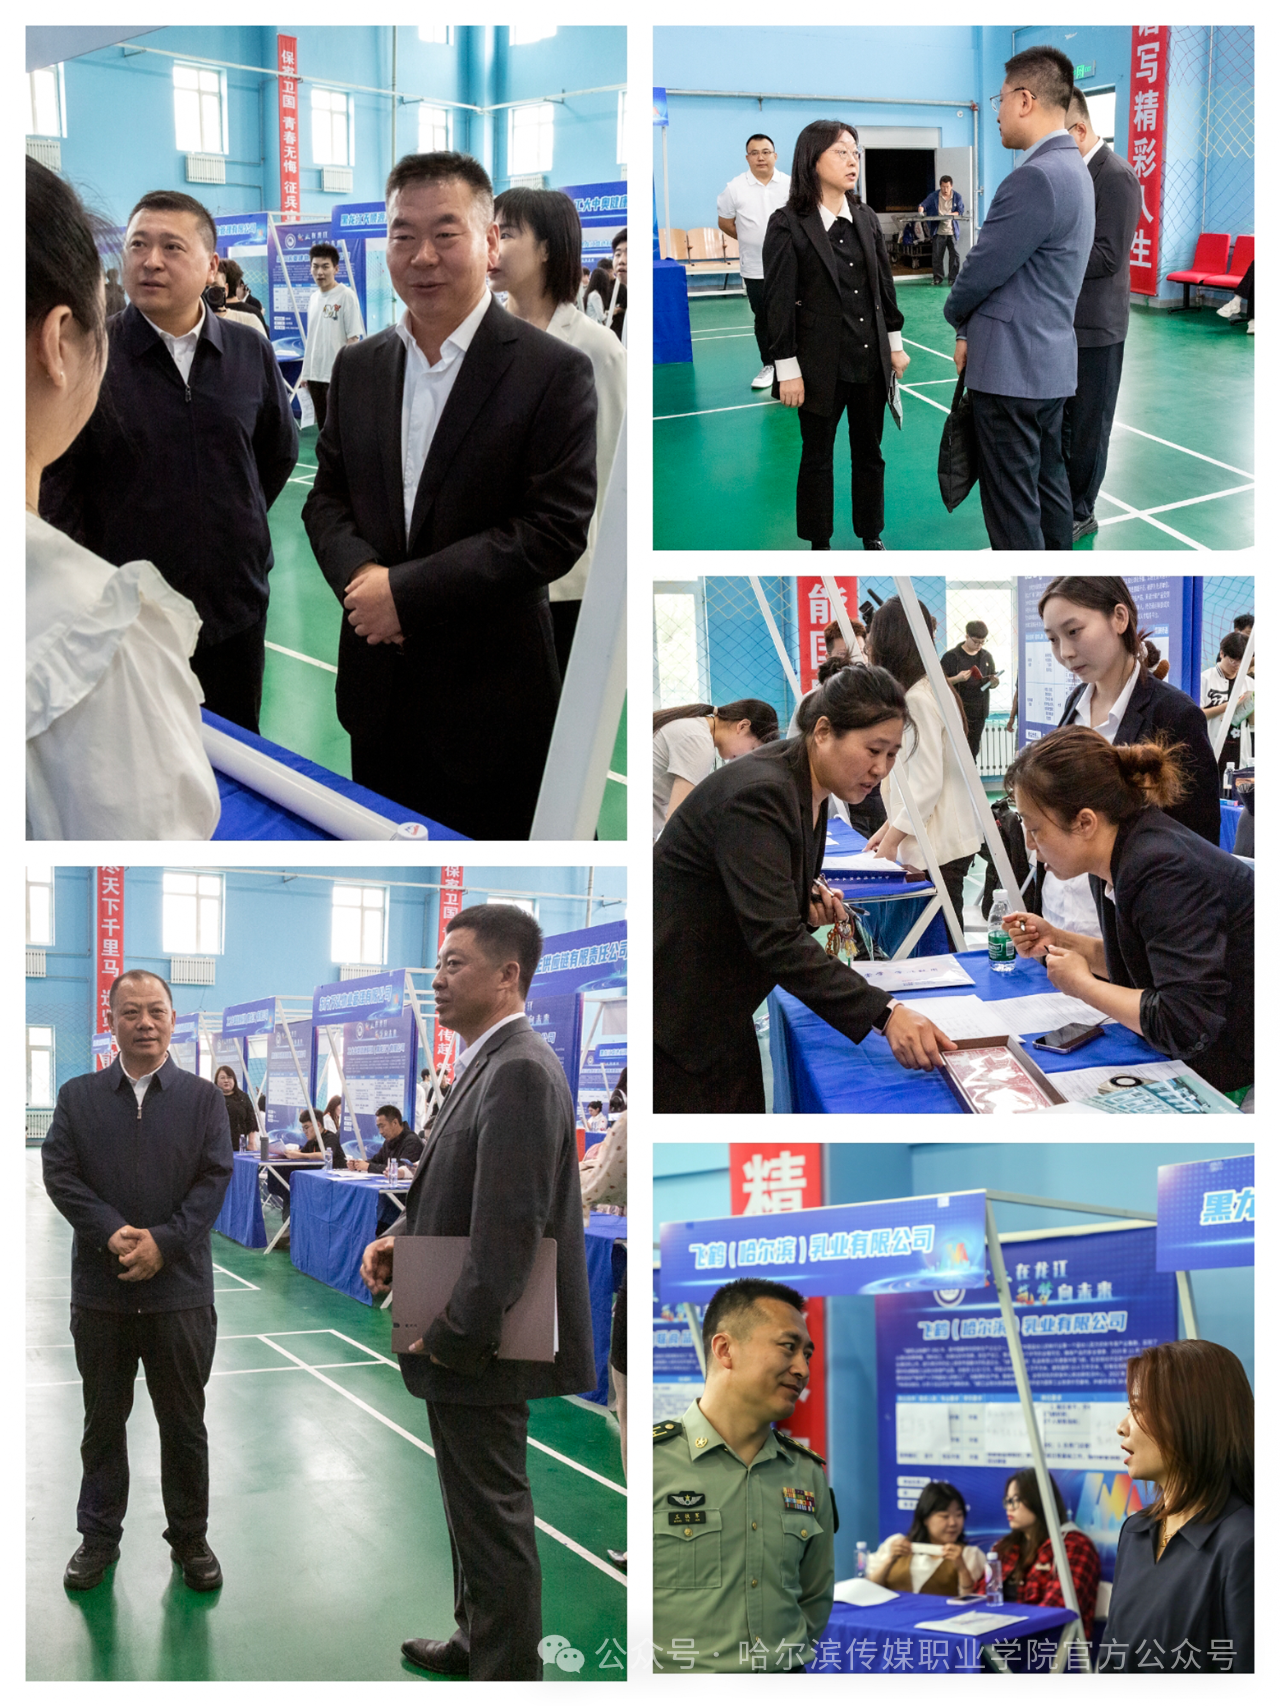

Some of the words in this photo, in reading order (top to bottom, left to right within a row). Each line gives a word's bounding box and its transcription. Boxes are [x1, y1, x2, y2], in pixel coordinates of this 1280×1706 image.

[282, 116, 297, 174] 青春无悔
[742, 1150, 806, 1214] 精
